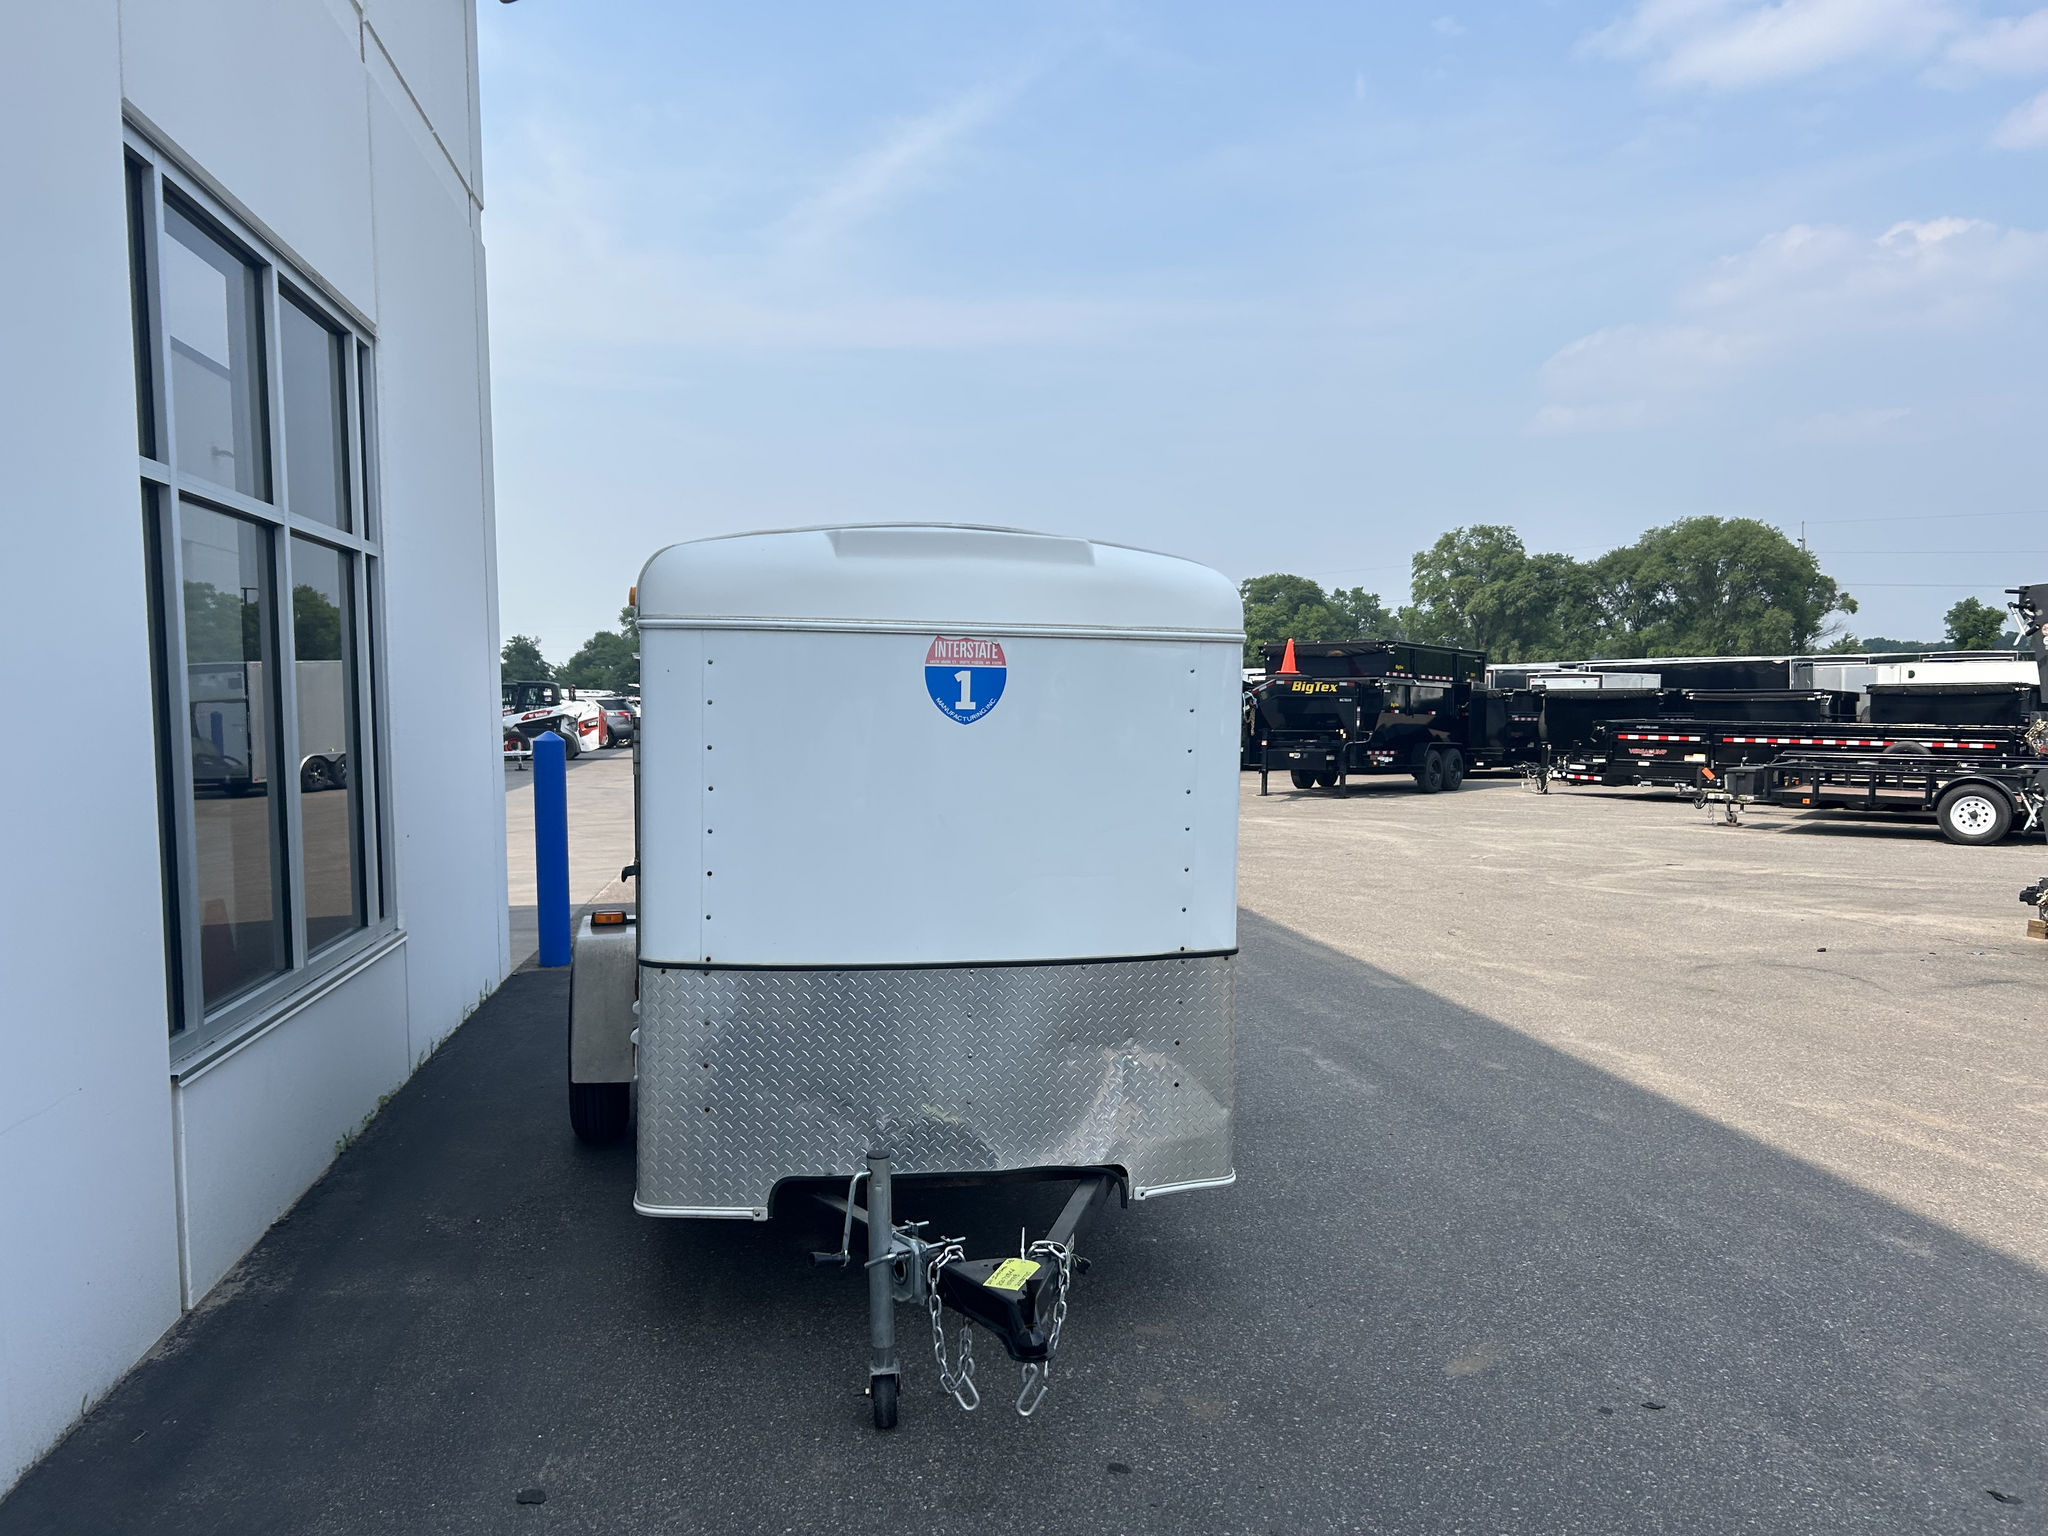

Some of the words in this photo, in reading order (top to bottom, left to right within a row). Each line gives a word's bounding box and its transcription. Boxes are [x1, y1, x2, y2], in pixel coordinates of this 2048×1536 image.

[934, 640, 999, 659] INTERSTATE
[953, 670, 977, 710] 1
[1291, 680, 1338, 695] BigTex
[935, 697, 988, 722] MANUFACTURING
